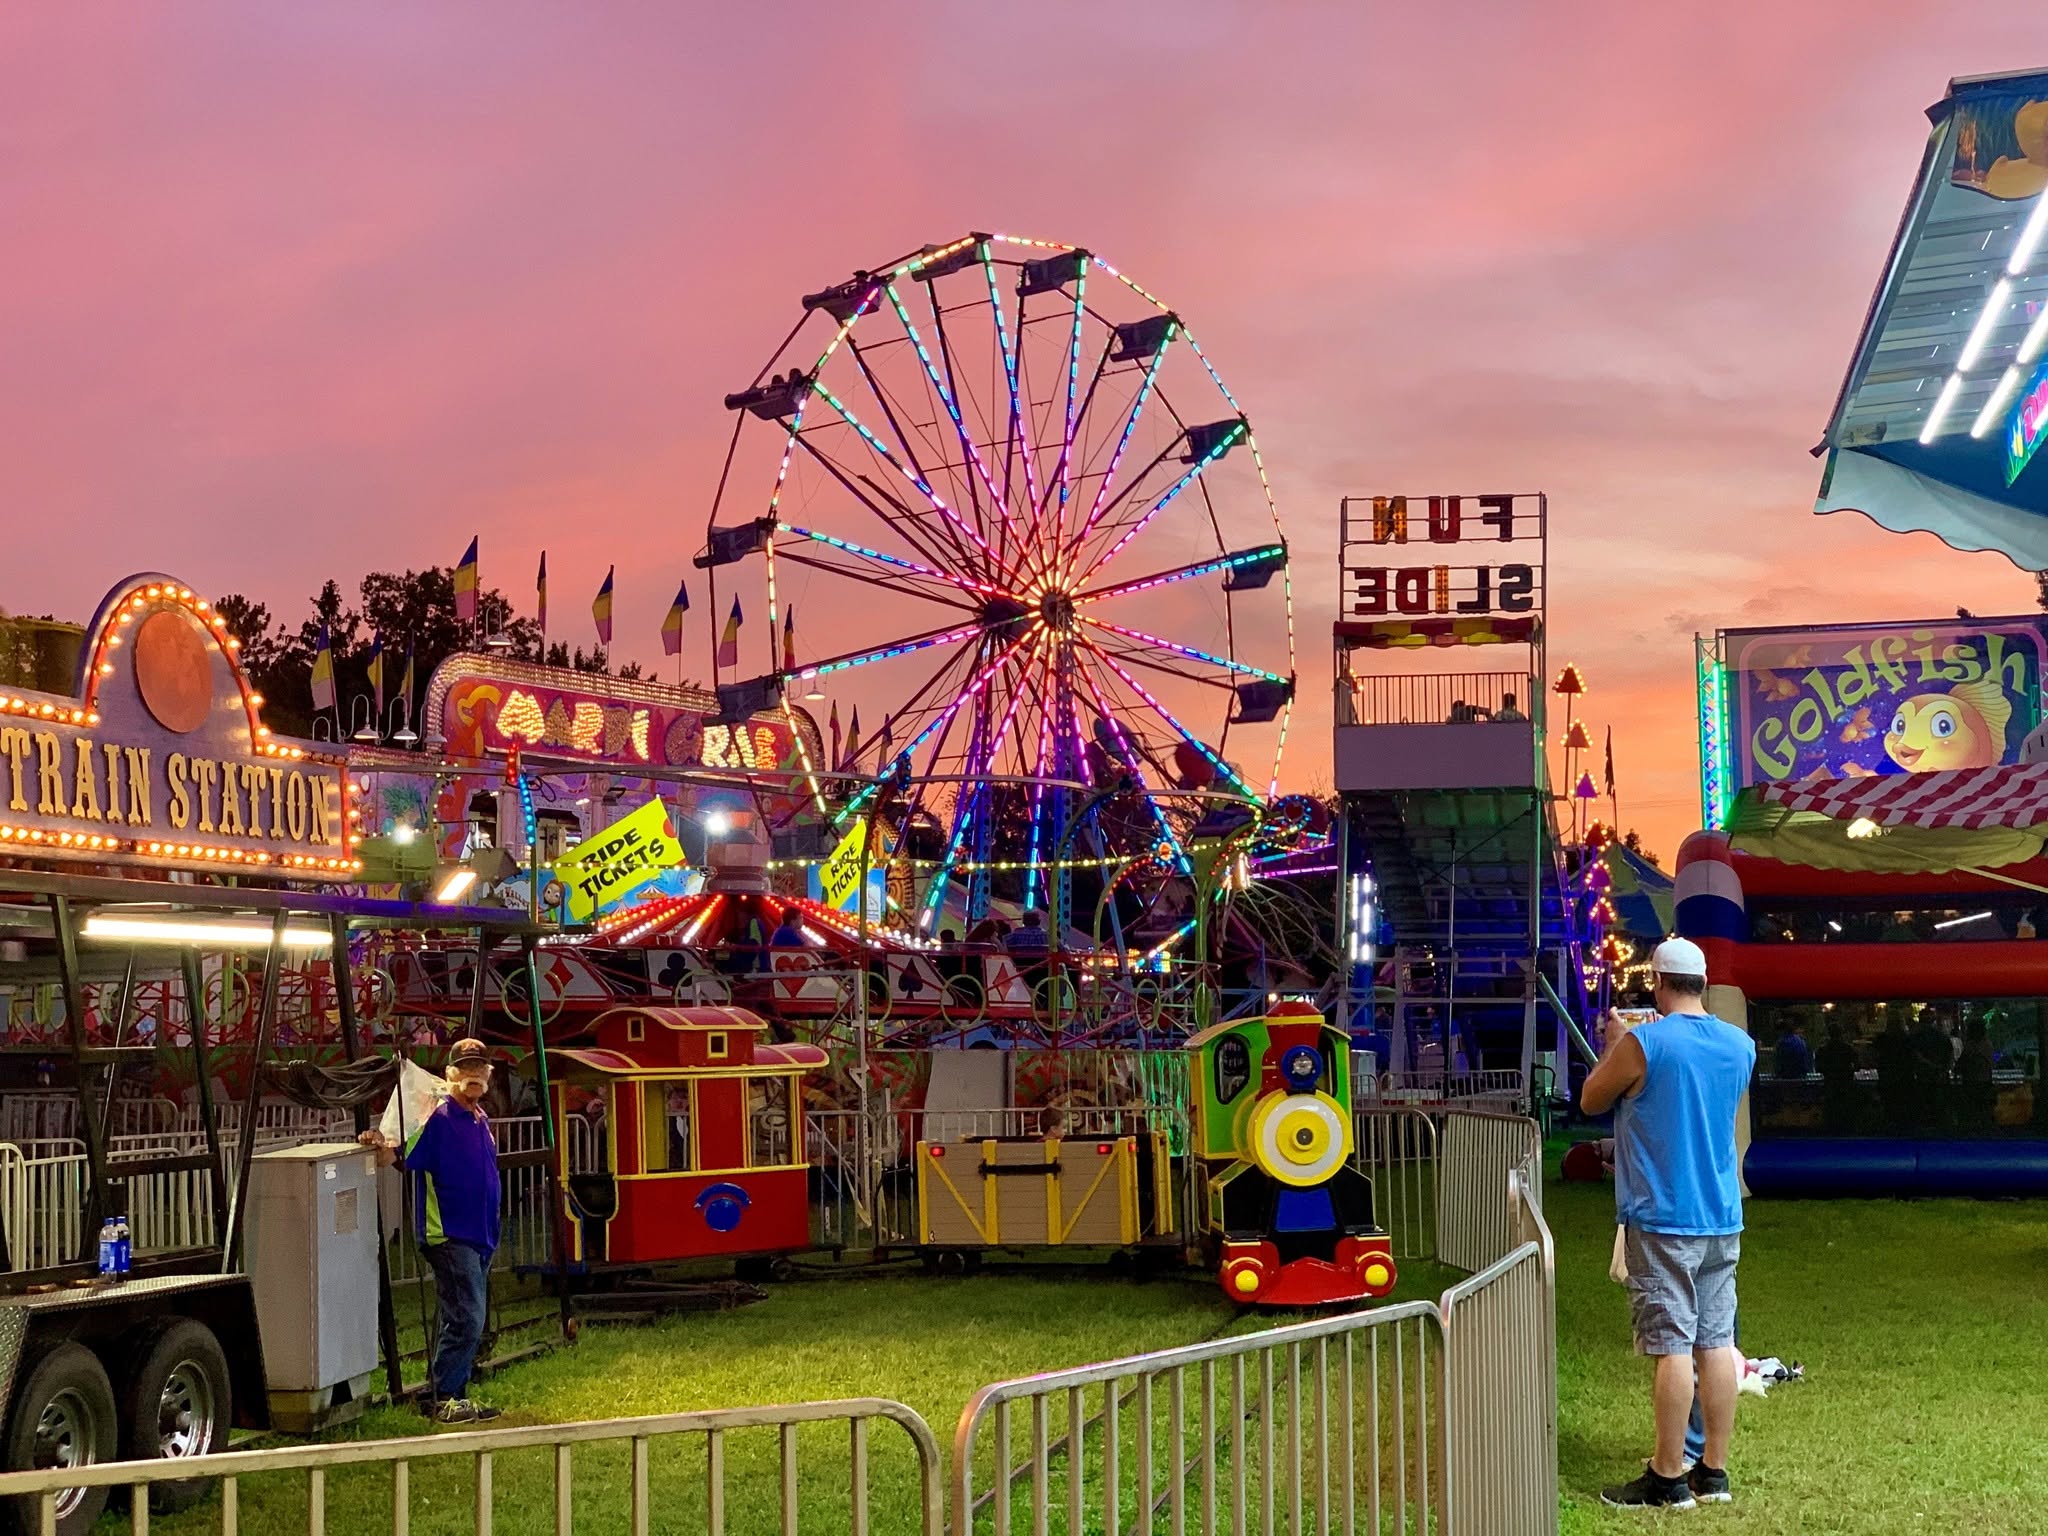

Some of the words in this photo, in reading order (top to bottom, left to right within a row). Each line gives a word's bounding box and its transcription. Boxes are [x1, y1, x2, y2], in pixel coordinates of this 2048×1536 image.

[1752, 630, 2027, 779] Goldfish
[1, 727, 151, 827] TRAIN
[168, 752, 331, 845] STATION
[579, 838, 664, 898] TICKETS
[580, 828, 642, 872] RIDE
[831, 842, 857, 877] RIDE
[831, 856, 862, 899] TICKET
